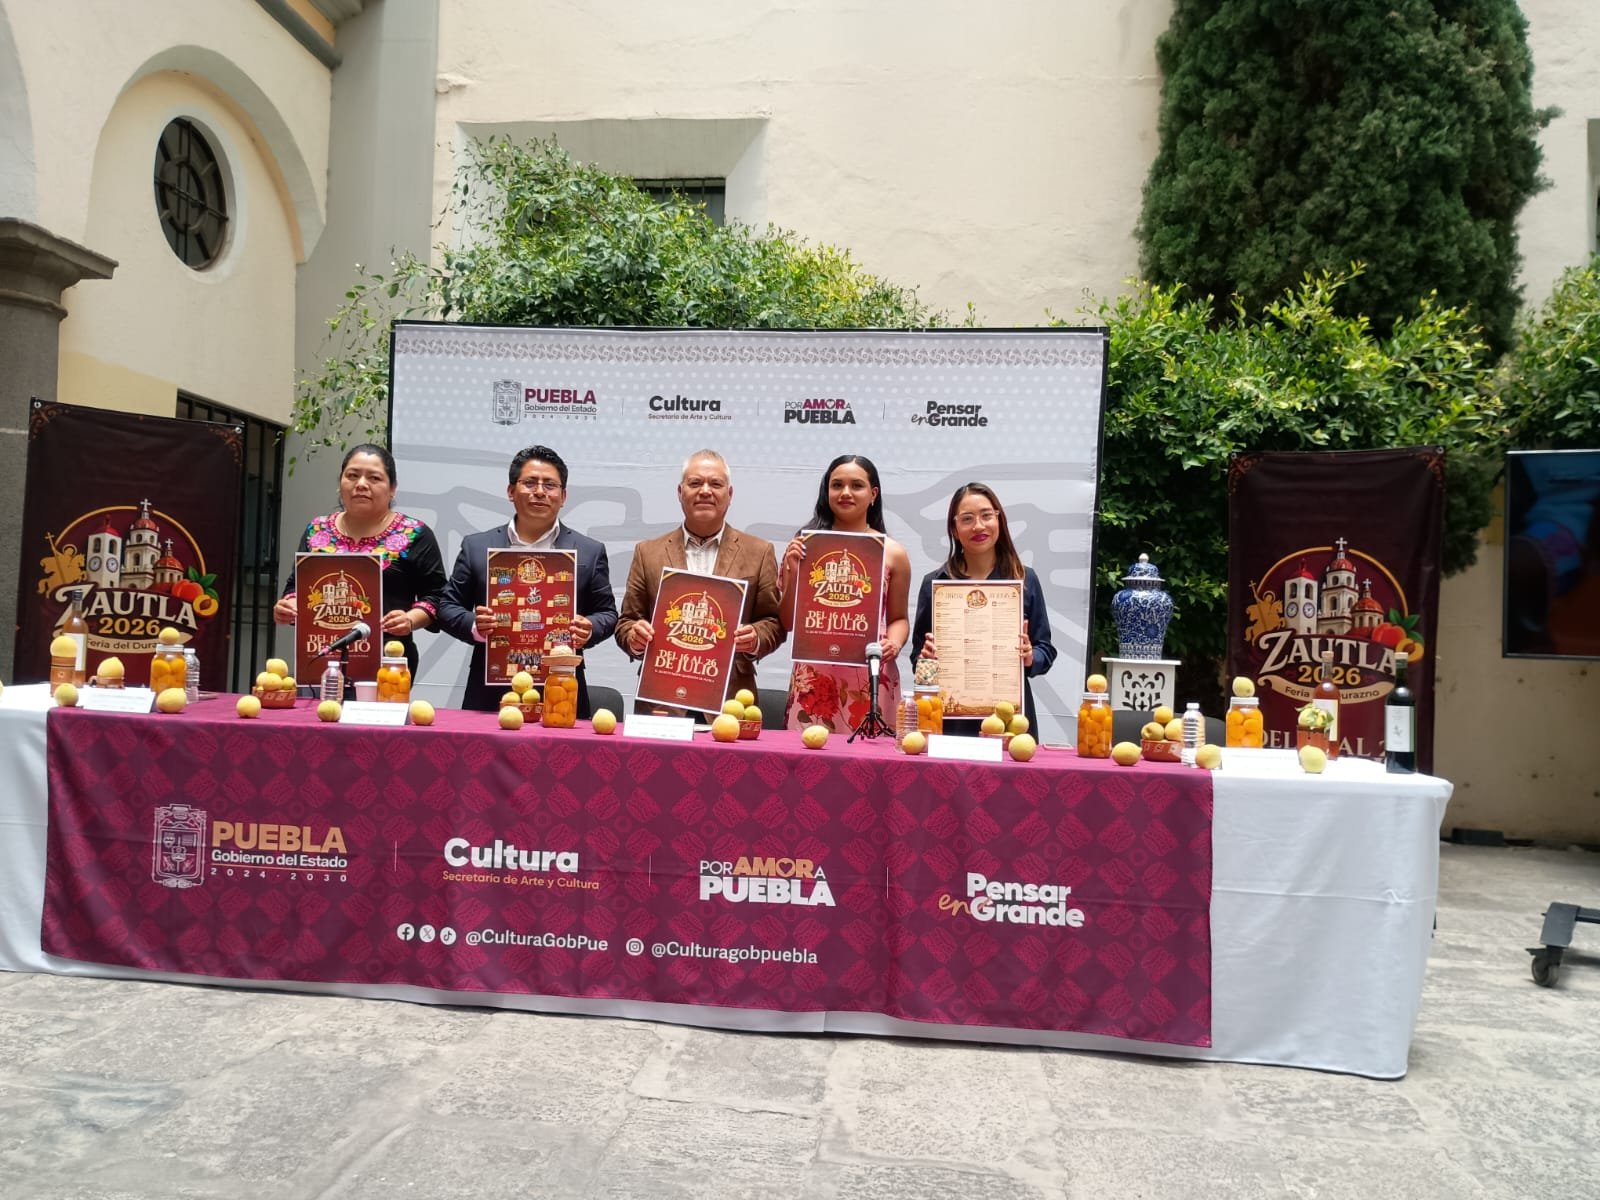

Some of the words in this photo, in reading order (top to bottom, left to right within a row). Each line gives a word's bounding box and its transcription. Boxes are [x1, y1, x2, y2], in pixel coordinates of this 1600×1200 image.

[524, 388, 597, 404] PUEBLA
[649, 394, 721, 412] Cultura
[784, 401, 802, 410] POR
[802, 398, 846, 410] AMOR
[524, 404, 558, 412] Gobierno
[572, 405, 597, 413] Estado
[926, 400, 982, 414] Pensar
[784, 410, 856, 424] PUEBLA
[911, 414, 930, 426] en
[928, 412, 988, 427] Grande
[814, 580, 864, 599] ZAUTLA
[828, 592, 850, 601] 2026
[55, 582, 198, 630] ZAUTLA
[313, 604, 364, 620] ZAUTLA
[99, 617, 160, 636] 2026
[328, 615, 350, 623] 2026
[805, 616, 824, 629] DE
[827, 616, 869, 632] JULIO
[667, 620, 718, 644] ZAUTLA
[682, 634, 704, 644] 2026
[88, 640, 110, 648] eria
[113, 640, 130, 650] del
[133, 642, 158, 650] Dura
[1259, 630, 1397, 676] ZAUTLA
[654, 656, 674, 670] DE
[676, 658, 719, 678] JULIO
[1284, 686, 1310, 698] Feria
[1341, 689, 1380, 700] urazno
[1338, 736, 1370, 757] AL
[212, 820, 347, 854] PUEBLA
[212, 850, 274, 865] Gobierno
[276, 854, 298, 866] del
[300, 855, 348, 868] Estado
[444, 837, 579, 873] Cultura
[210, 868, 266, 878] 2024
[290, 872, 347, 882] 2030
[700, 860, 733, 876] POR
[733, 856, 815, 878] AMOR
[814, 866, 826, 880] A
[442, 870, 500, 884] Secretaría
[503, 874, 518, 885] de
[520, 876, 544, 886] Arte
[547, 879, 555, 889] y
[556, 878, 600, 890] Cultura
[966, 872, 1072, 904] Pensar
[700, 875, 836, 907] PUEBLA
[938, 894, 972, 916] en
[970, 896, 1086, 928] Grande
[465, 928, 609, 951] @CulturaGobPue
[651, 941, 818, 964] @Culturagobpuebla
